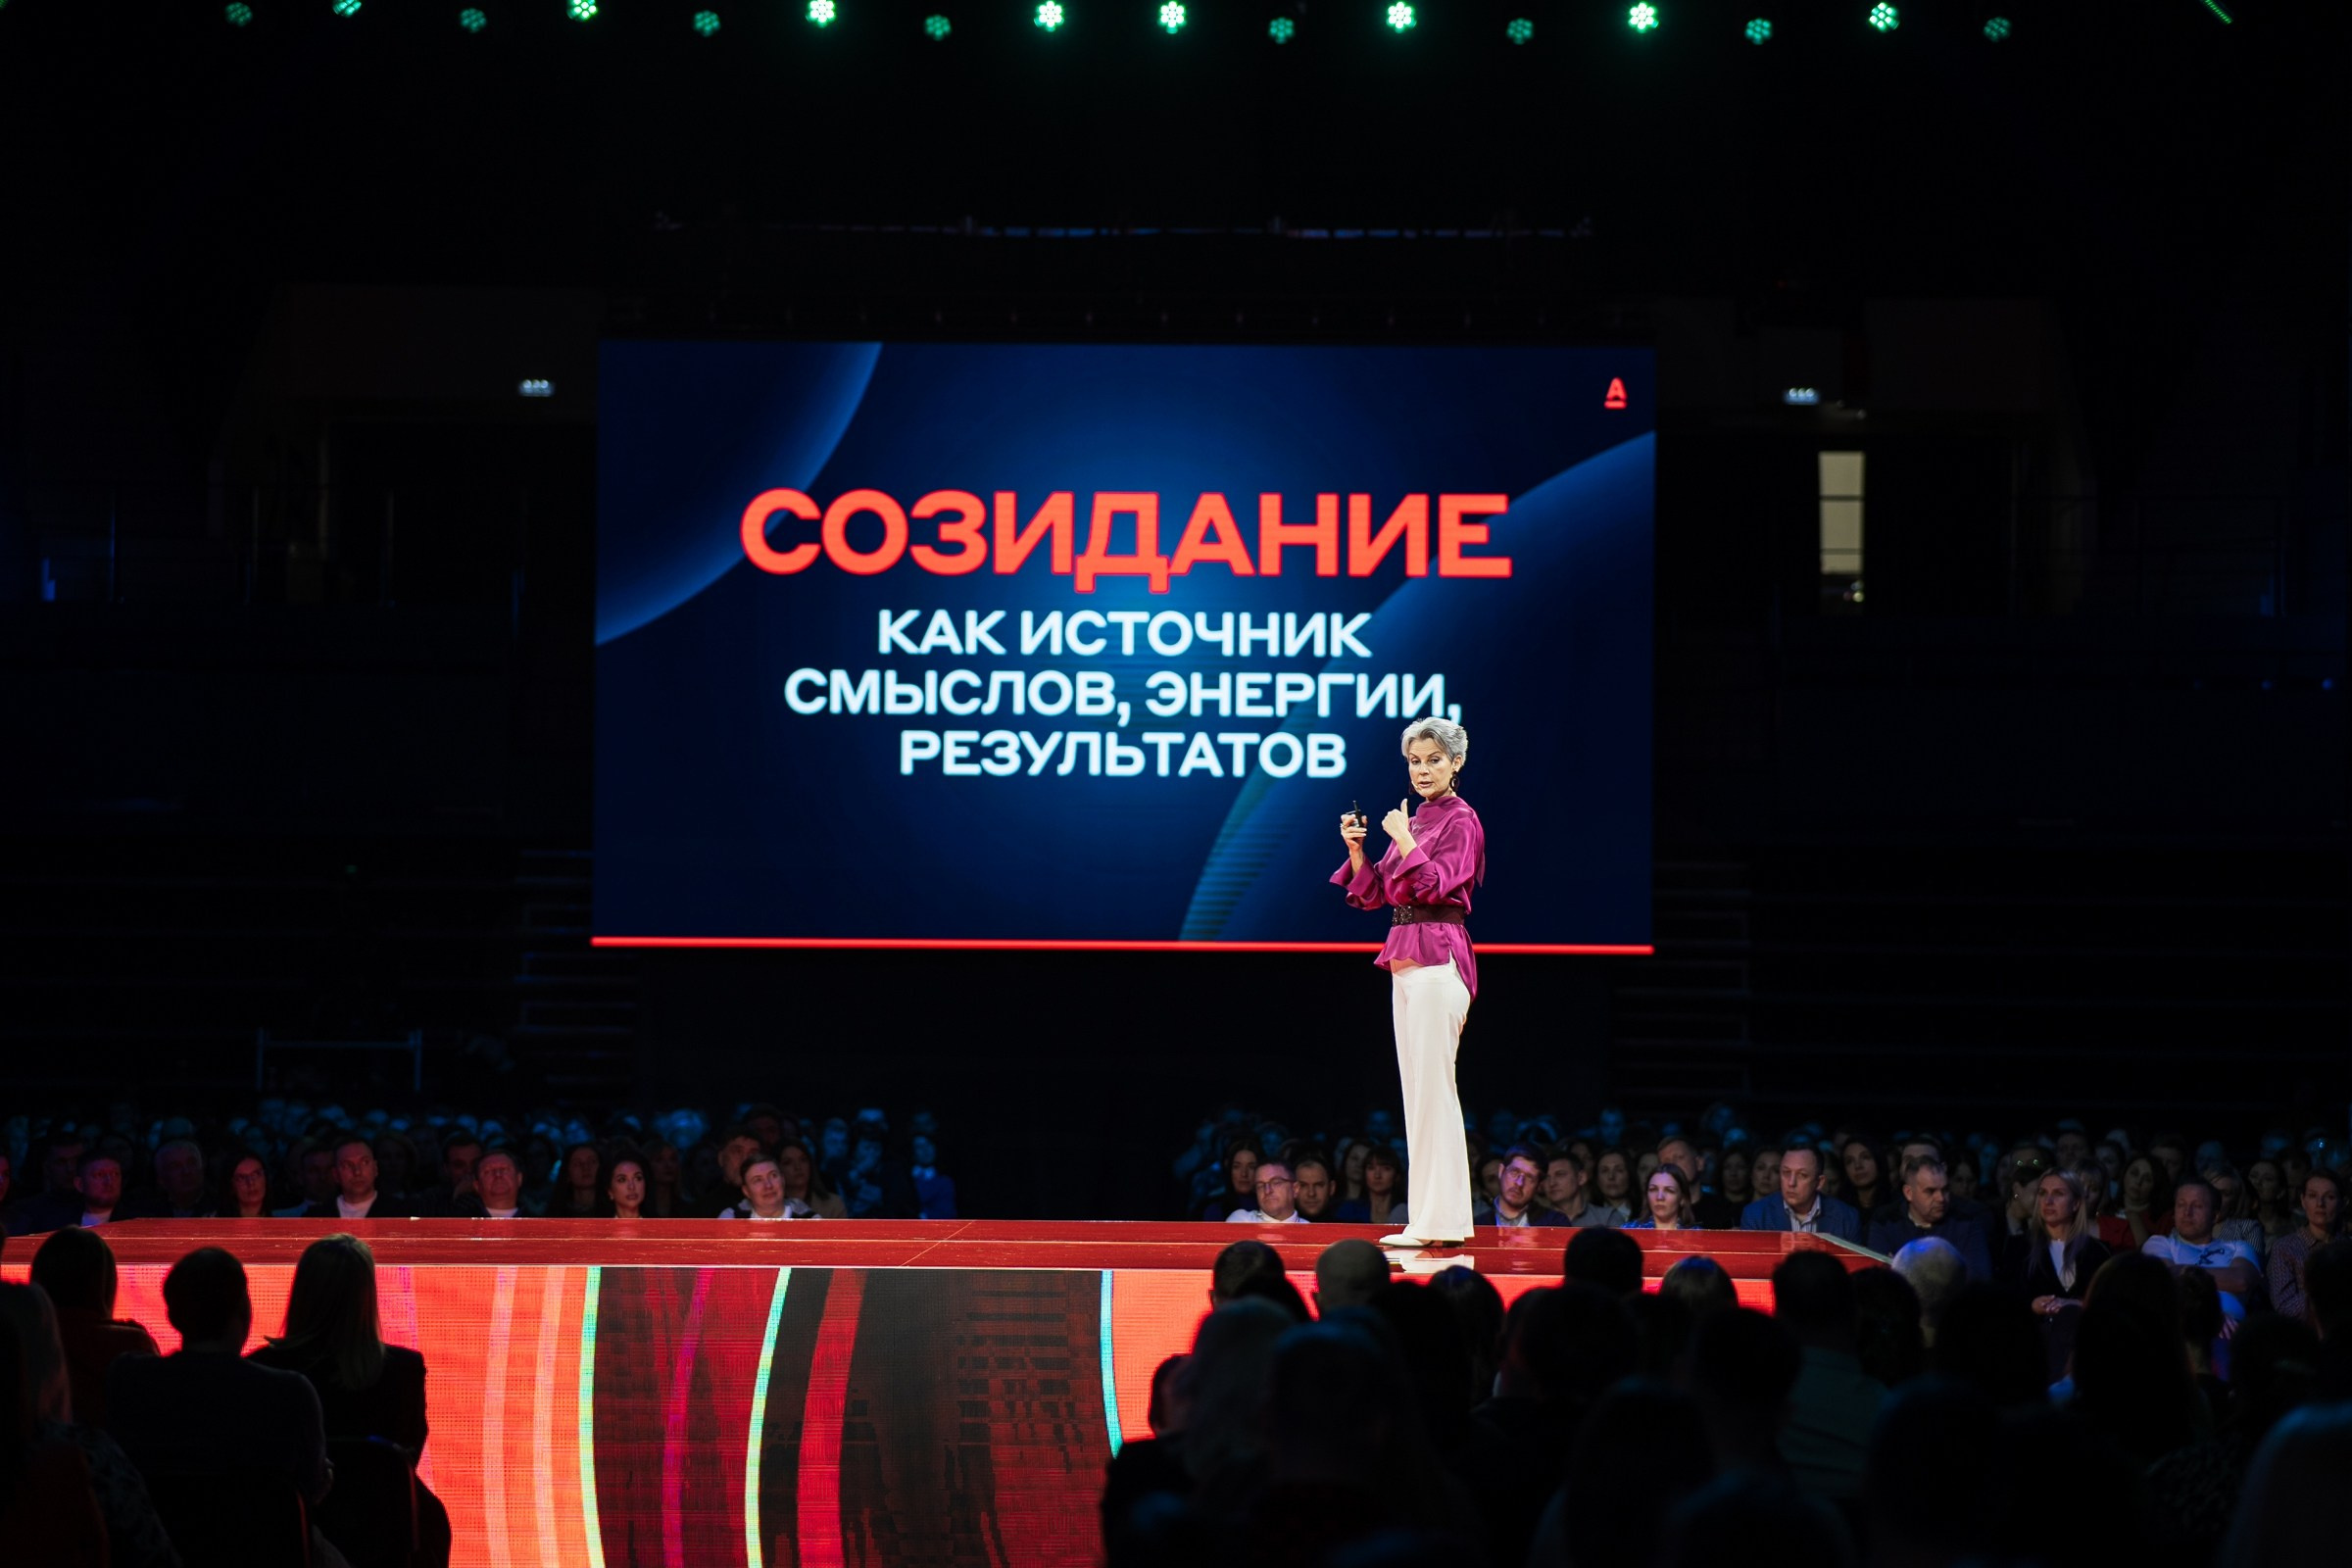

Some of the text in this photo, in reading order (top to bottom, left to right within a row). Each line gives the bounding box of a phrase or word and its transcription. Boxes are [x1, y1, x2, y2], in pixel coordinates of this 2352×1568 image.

[740, 487, 1513, 594] СОЗИДАНИЕ
[878, 610, 1372, 658] КАК ИСТОЧНИК
[785, 668, 1462, 727] СМЫСЛОВ, ЭНЕРГИИ,
[900, 731, 1347, 778] РЕЗУЛЬТАТОВ
